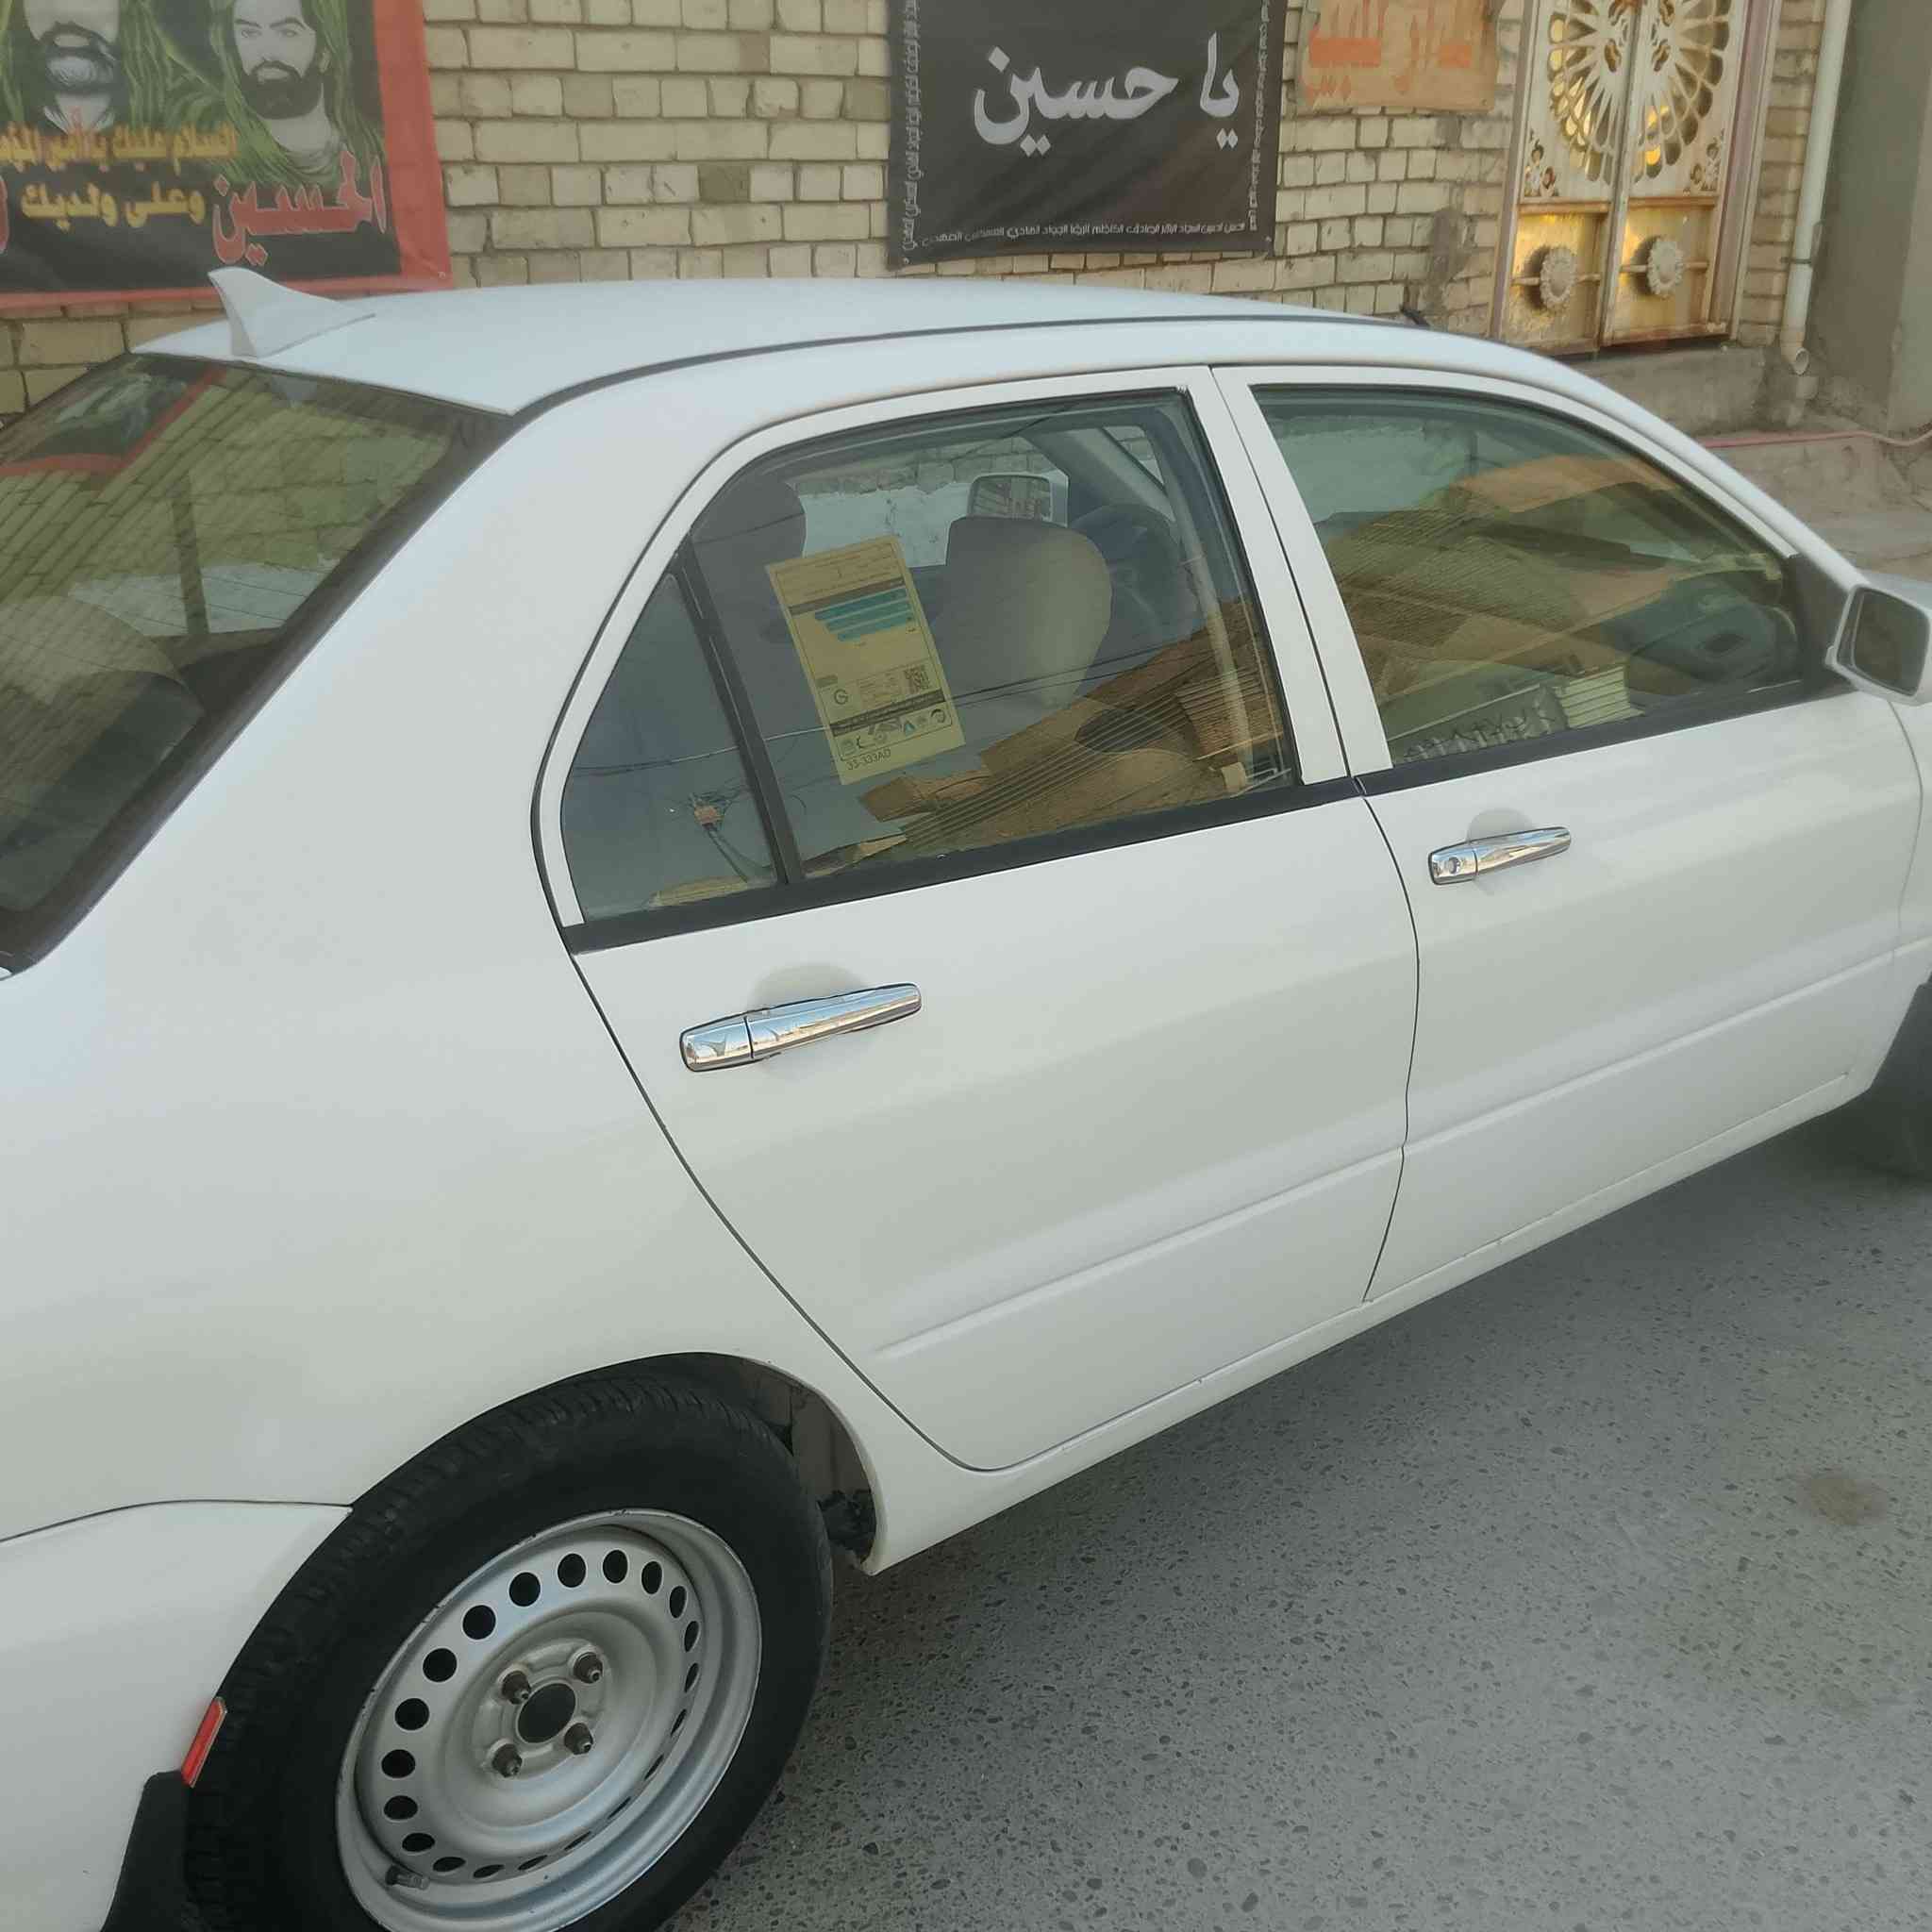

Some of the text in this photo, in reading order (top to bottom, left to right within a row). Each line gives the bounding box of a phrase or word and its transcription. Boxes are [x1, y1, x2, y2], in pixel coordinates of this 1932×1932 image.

[973, 45, 1180, 158] حسين
[1199, 31, 1241, 150] يا
[125, 180, 206, 226] وعلى
